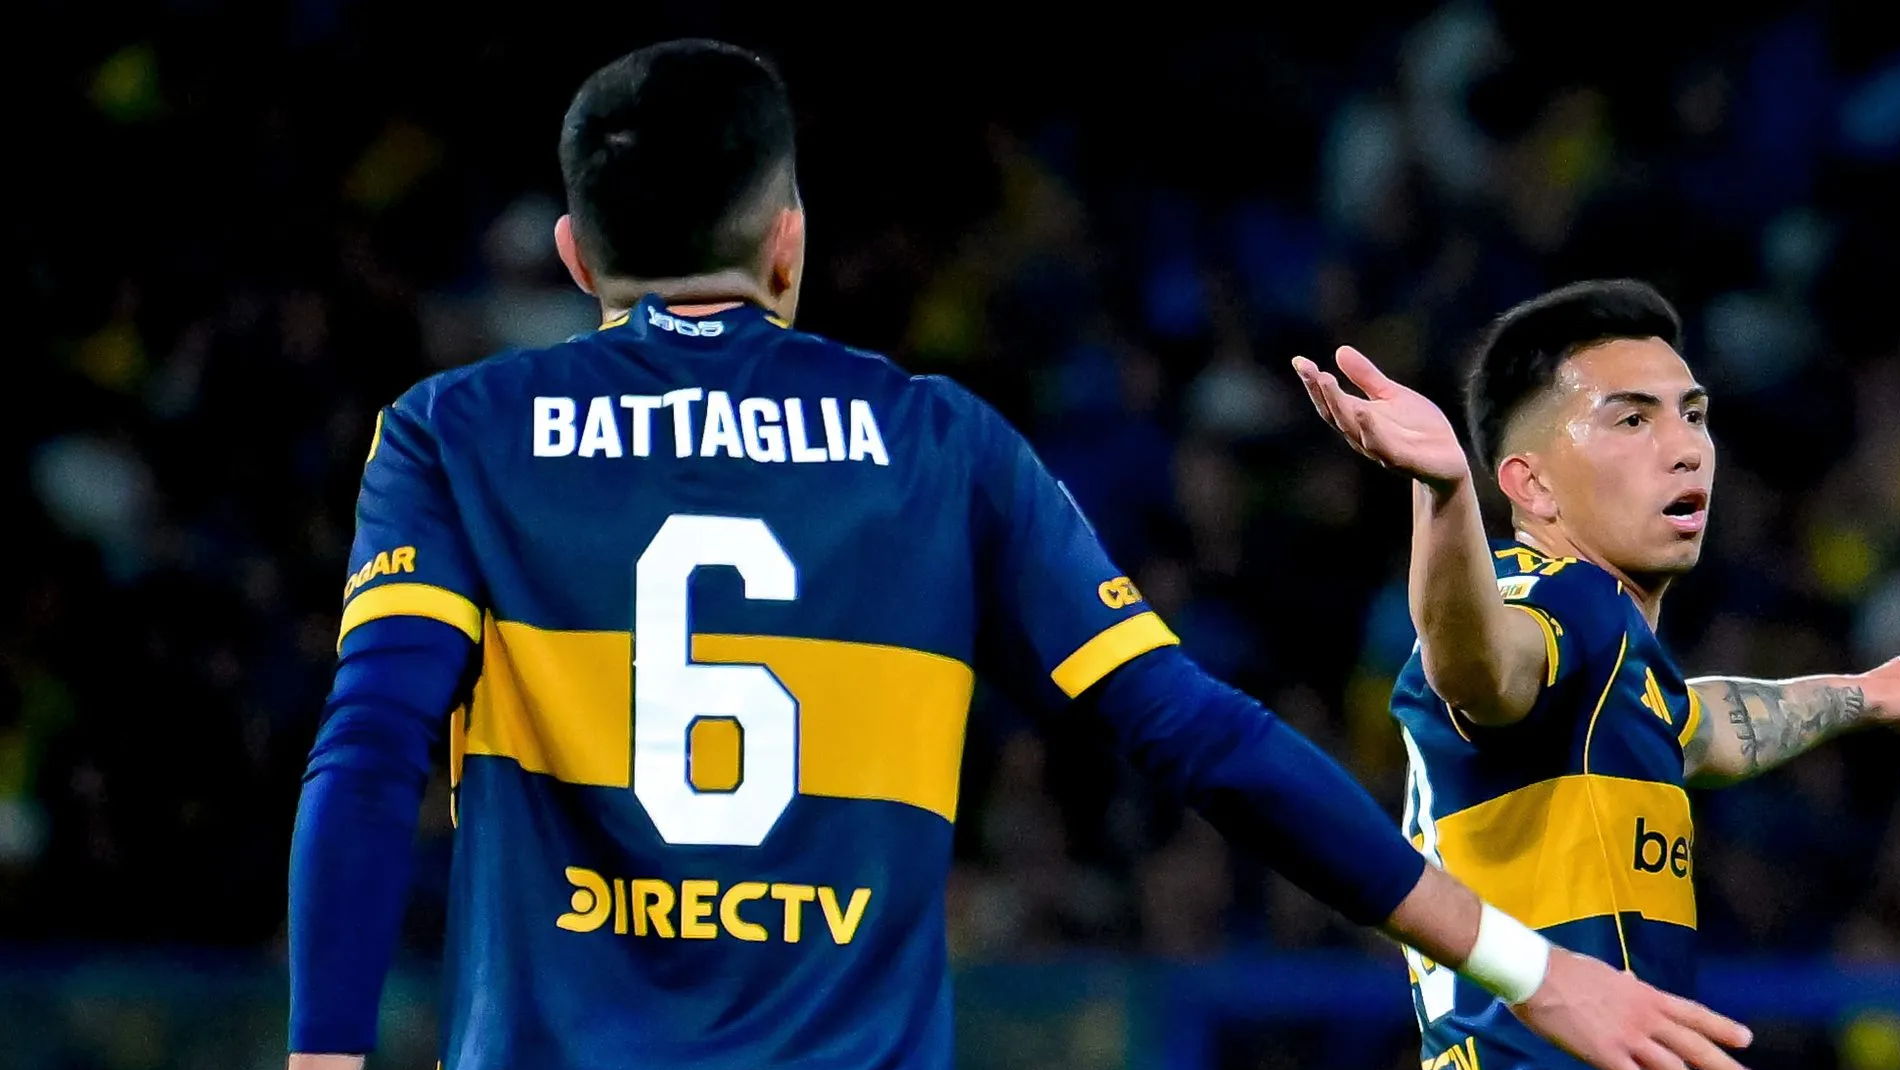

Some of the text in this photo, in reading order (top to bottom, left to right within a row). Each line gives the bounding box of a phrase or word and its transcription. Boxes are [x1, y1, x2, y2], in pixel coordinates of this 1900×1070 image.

[532, 388, 890, 466] BATTAGLIA
[633, 514, 799, 846] 6
[555, 865, 873, 946] DIRECTV
